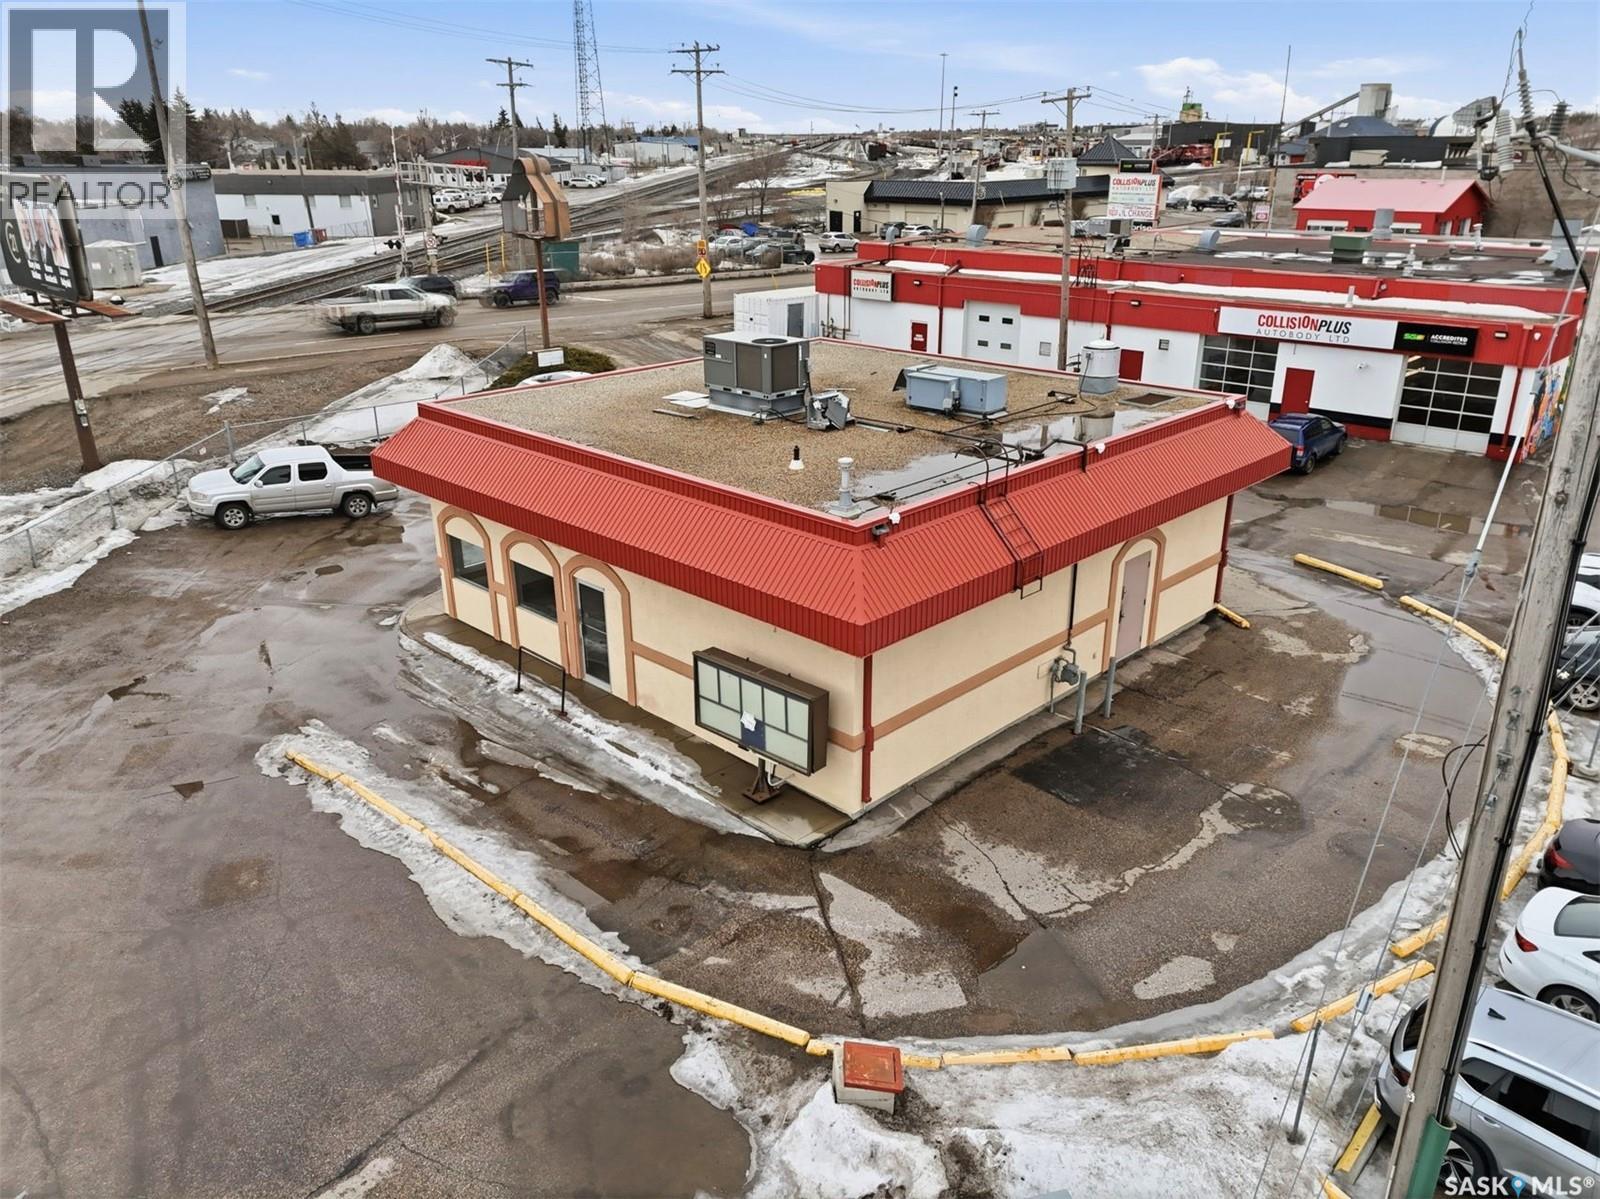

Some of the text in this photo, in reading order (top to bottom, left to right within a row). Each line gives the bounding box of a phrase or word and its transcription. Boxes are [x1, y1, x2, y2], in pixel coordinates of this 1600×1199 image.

[1256, 328, 1350, 344] AUTOBODY LTD
[1430, 334, 1468, 342] ACCREDITED
